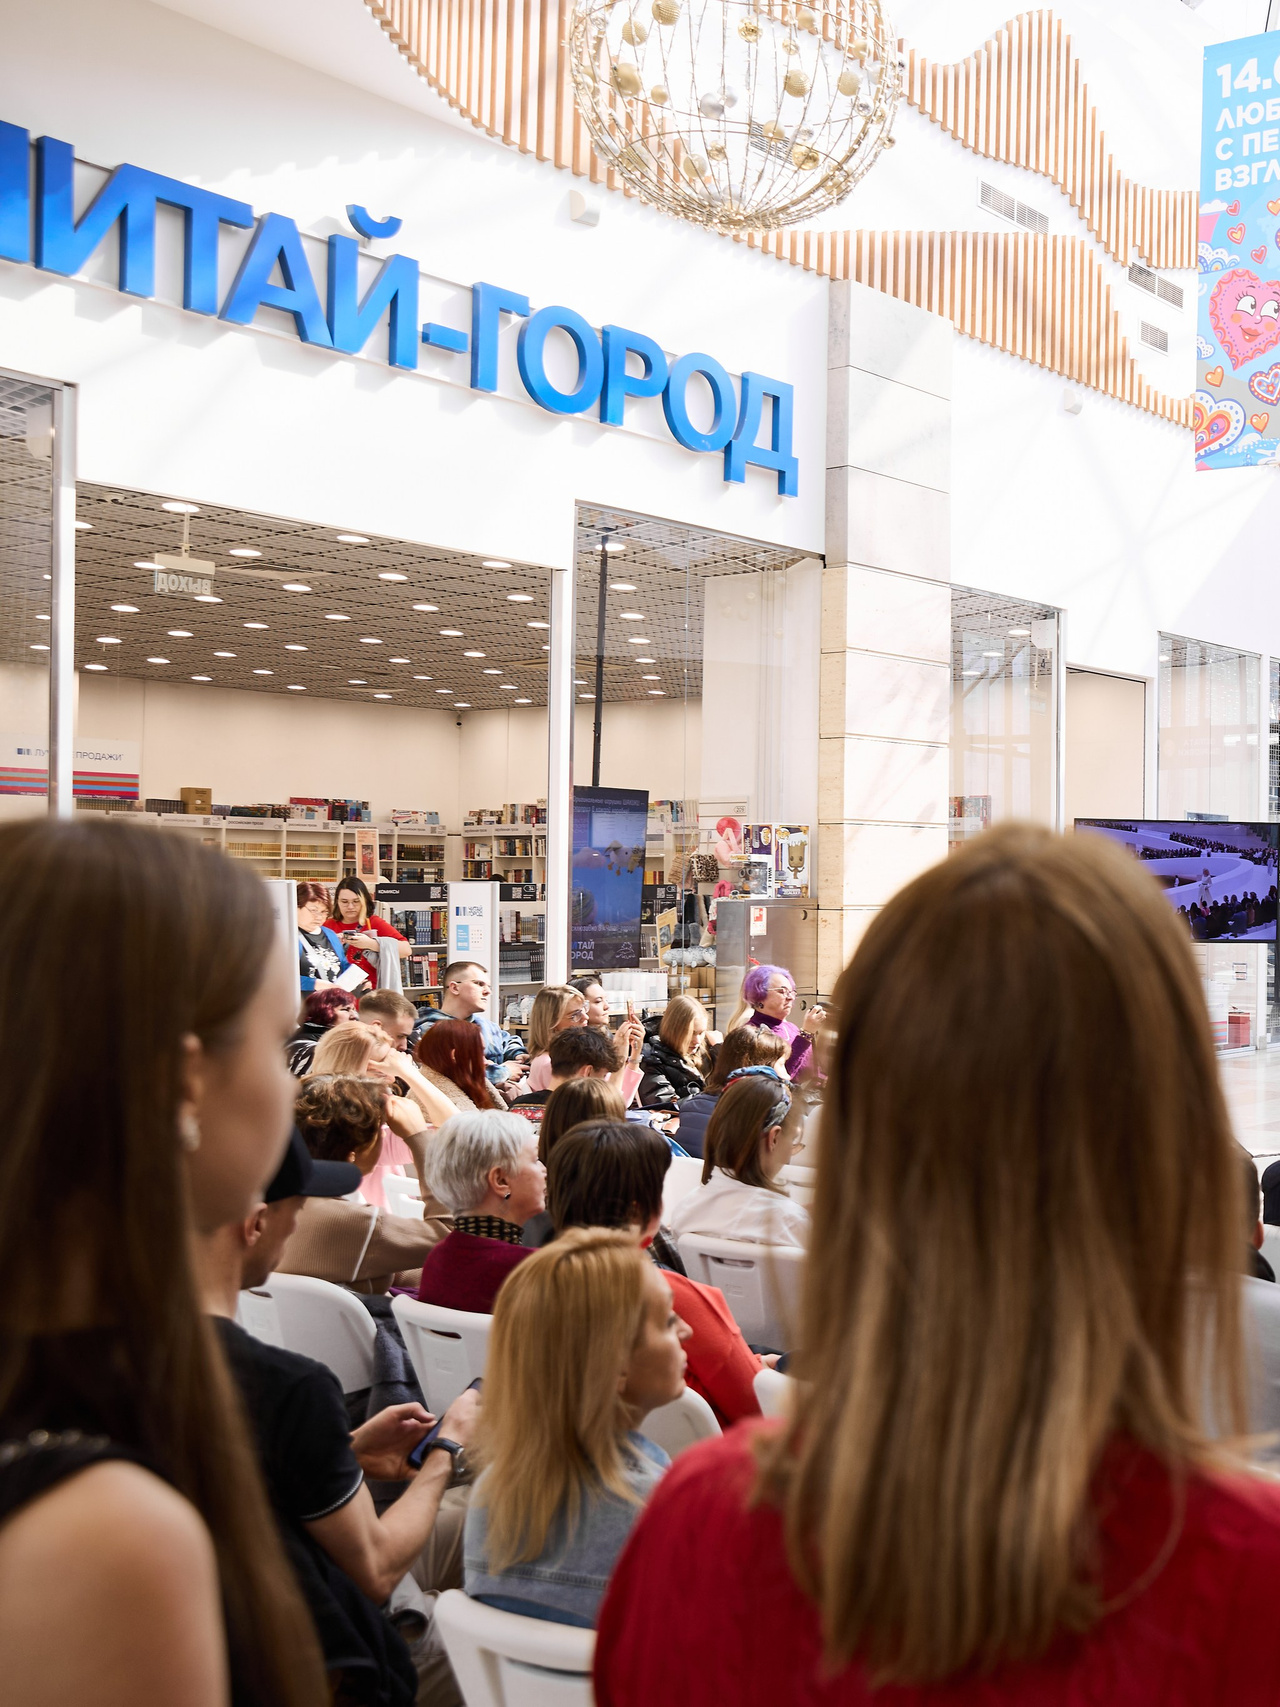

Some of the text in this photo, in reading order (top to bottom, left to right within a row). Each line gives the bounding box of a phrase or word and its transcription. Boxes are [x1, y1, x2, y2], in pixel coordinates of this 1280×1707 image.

[1215, 137, 1234, 161] С
[572, 939, 595, 950] ИТАЙ
[571, 951, 594, 960] ОРОД
